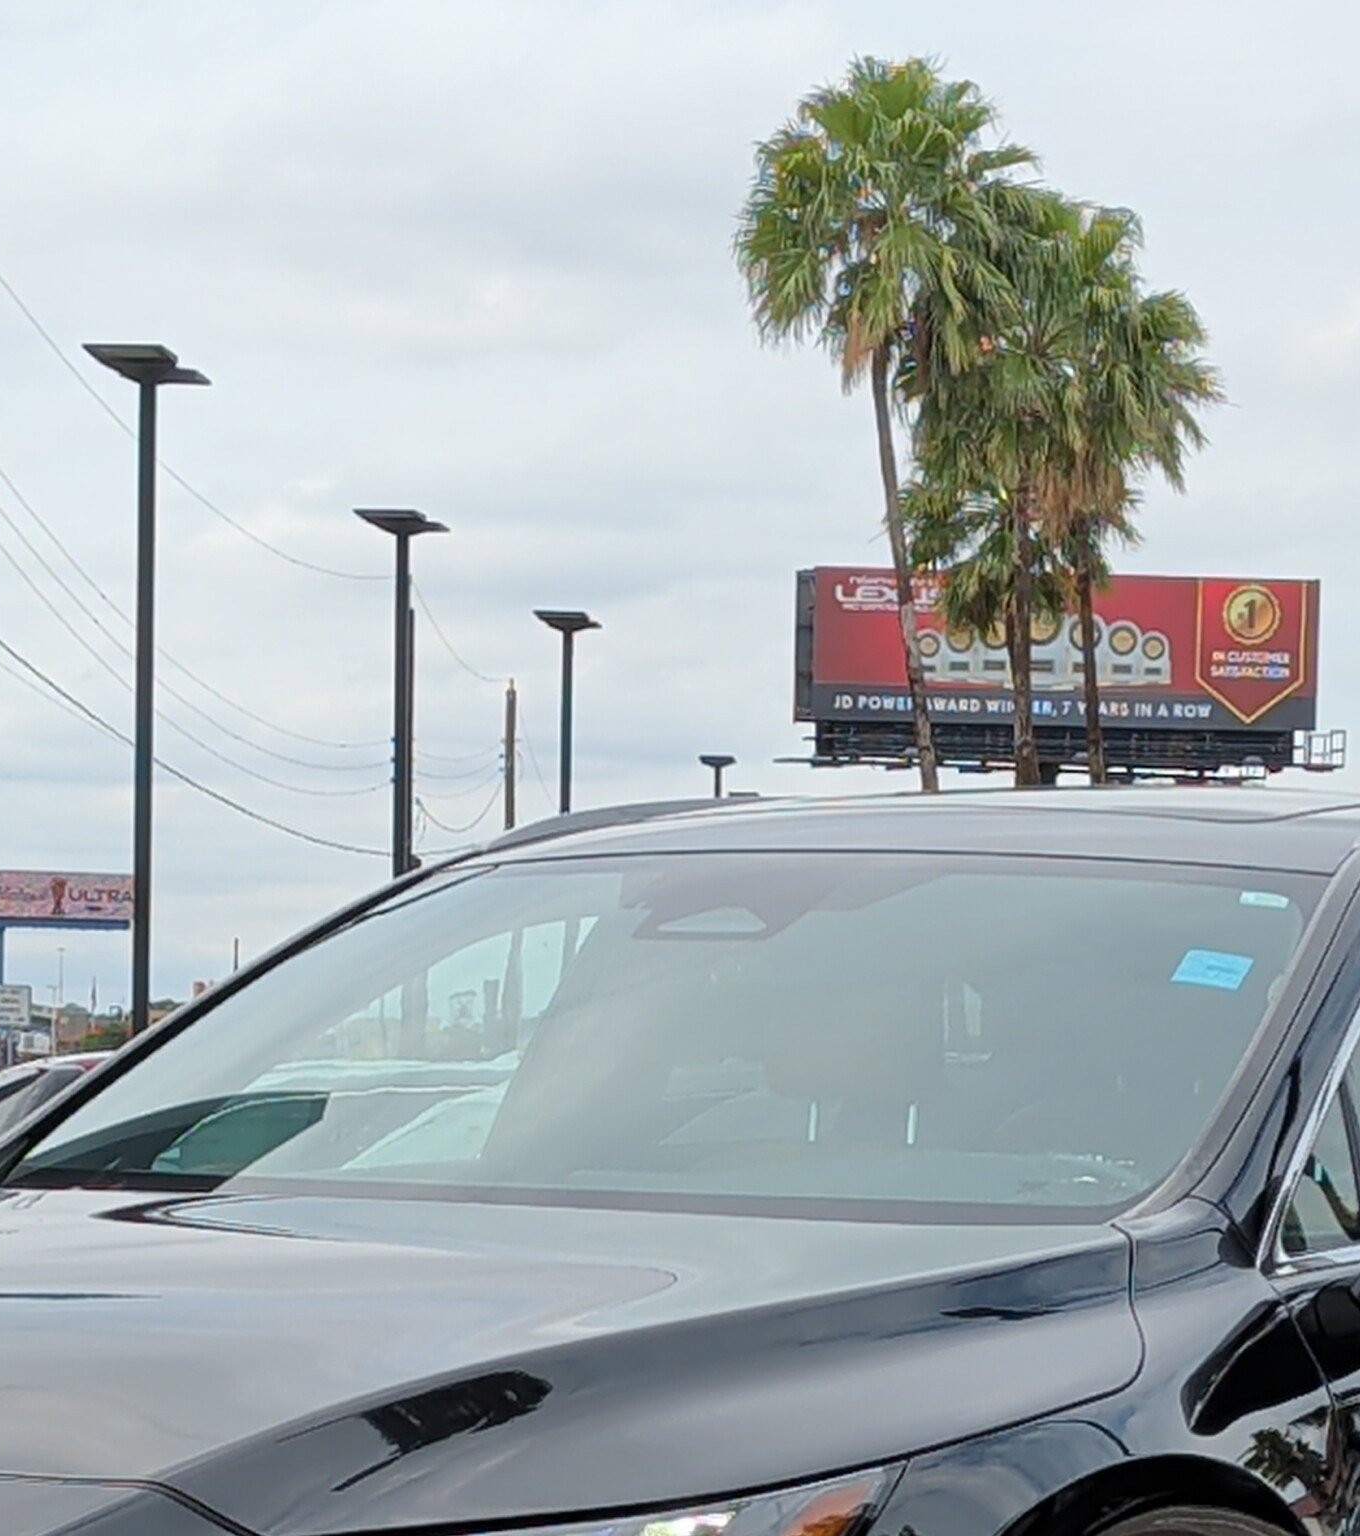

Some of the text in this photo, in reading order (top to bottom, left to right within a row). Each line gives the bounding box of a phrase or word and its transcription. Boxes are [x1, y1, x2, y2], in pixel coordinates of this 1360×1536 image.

[834, 695, 853, 709] JD
[985, 699, 1057, 717] WINER,
[1077, 701, 1129, 716] YARS
[1134, 703, 1152, 717] IN
[1157, 704, 1169, 718] A
[1172, 704, 1212, 718] ROW
[68, 887, 135, 903] ULTRA
